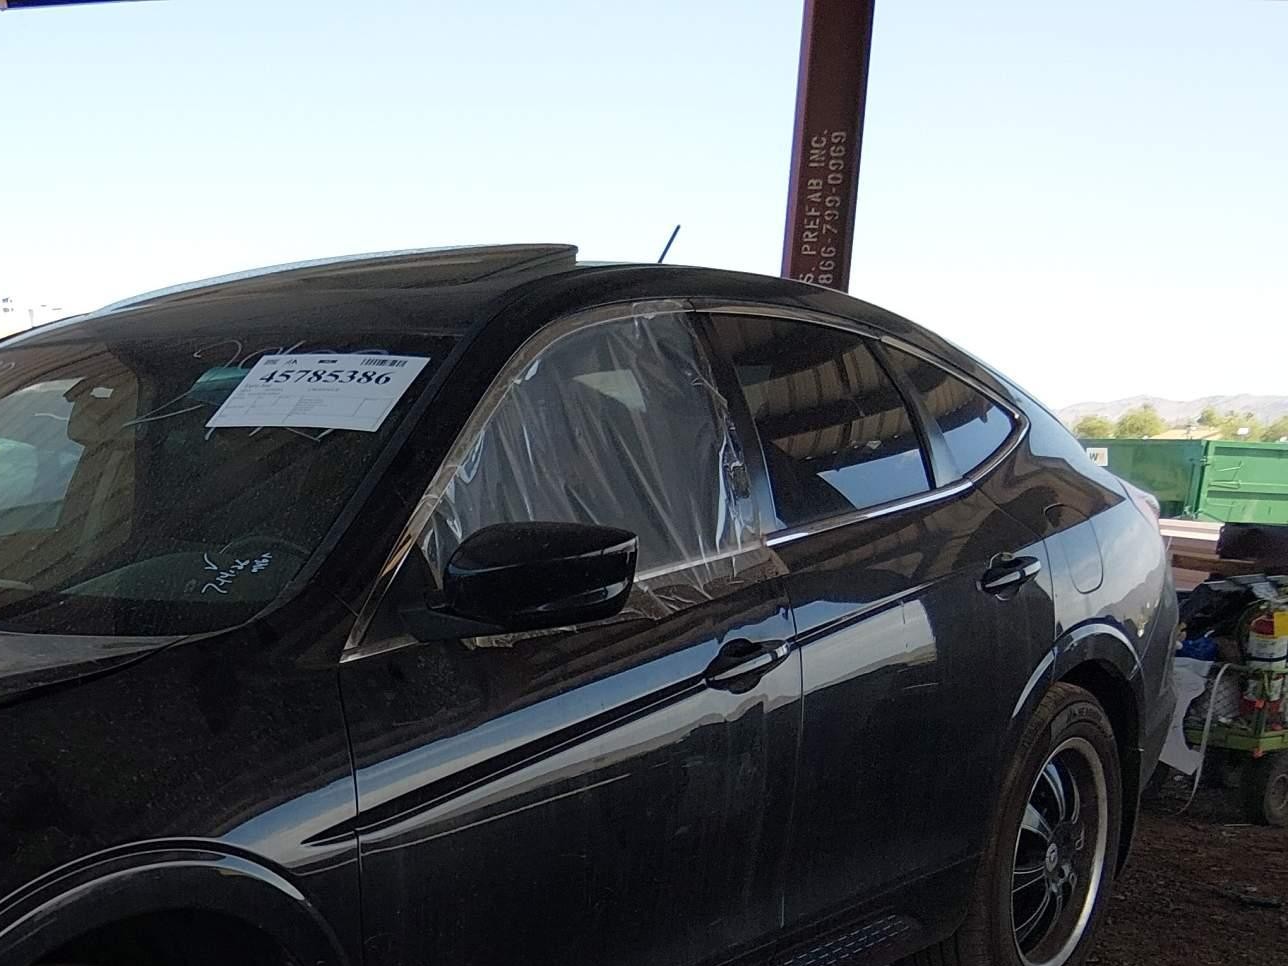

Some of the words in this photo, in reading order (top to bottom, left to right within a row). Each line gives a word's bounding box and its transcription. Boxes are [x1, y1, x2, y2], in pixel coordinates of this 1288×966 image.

[808, 129, 829, 167] INC.
[801, 178, 823, 255] PREFAB
[818, 130, 847, 285] 866-799-0969
[259, 369, 392, 385] 45785386
